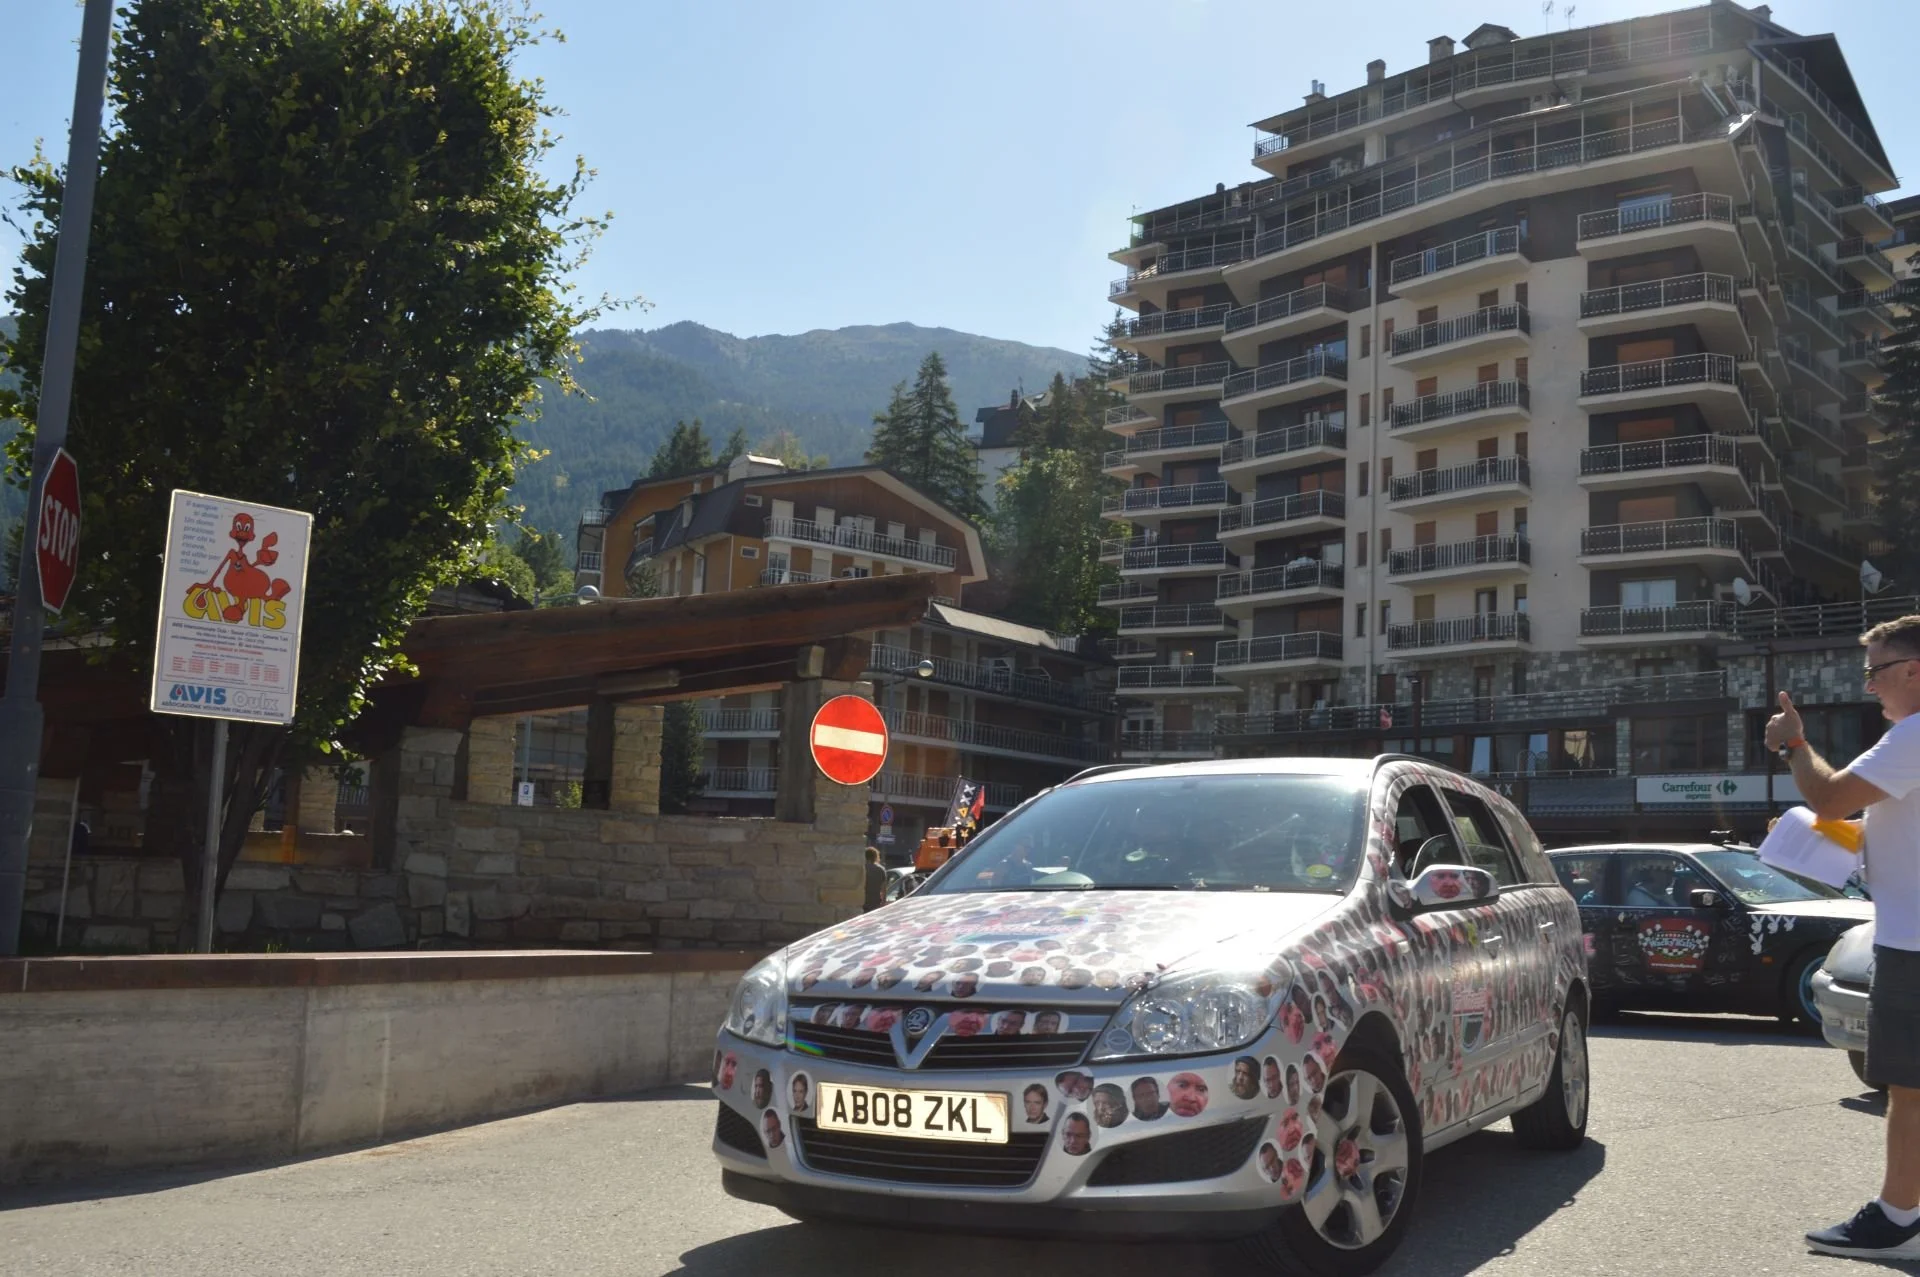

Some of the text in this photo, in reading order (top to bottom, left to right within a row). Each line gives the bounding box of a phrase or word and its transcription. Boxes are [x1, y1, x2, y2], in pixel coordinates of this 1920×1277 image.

[41, 495, 78, 566] STOP
[170, 684, 280, 711] AVIS Oulx
[1662, 781, 1712, 792] Carrefour
[832, 1089, 992, 1134] AB08 ZKL
